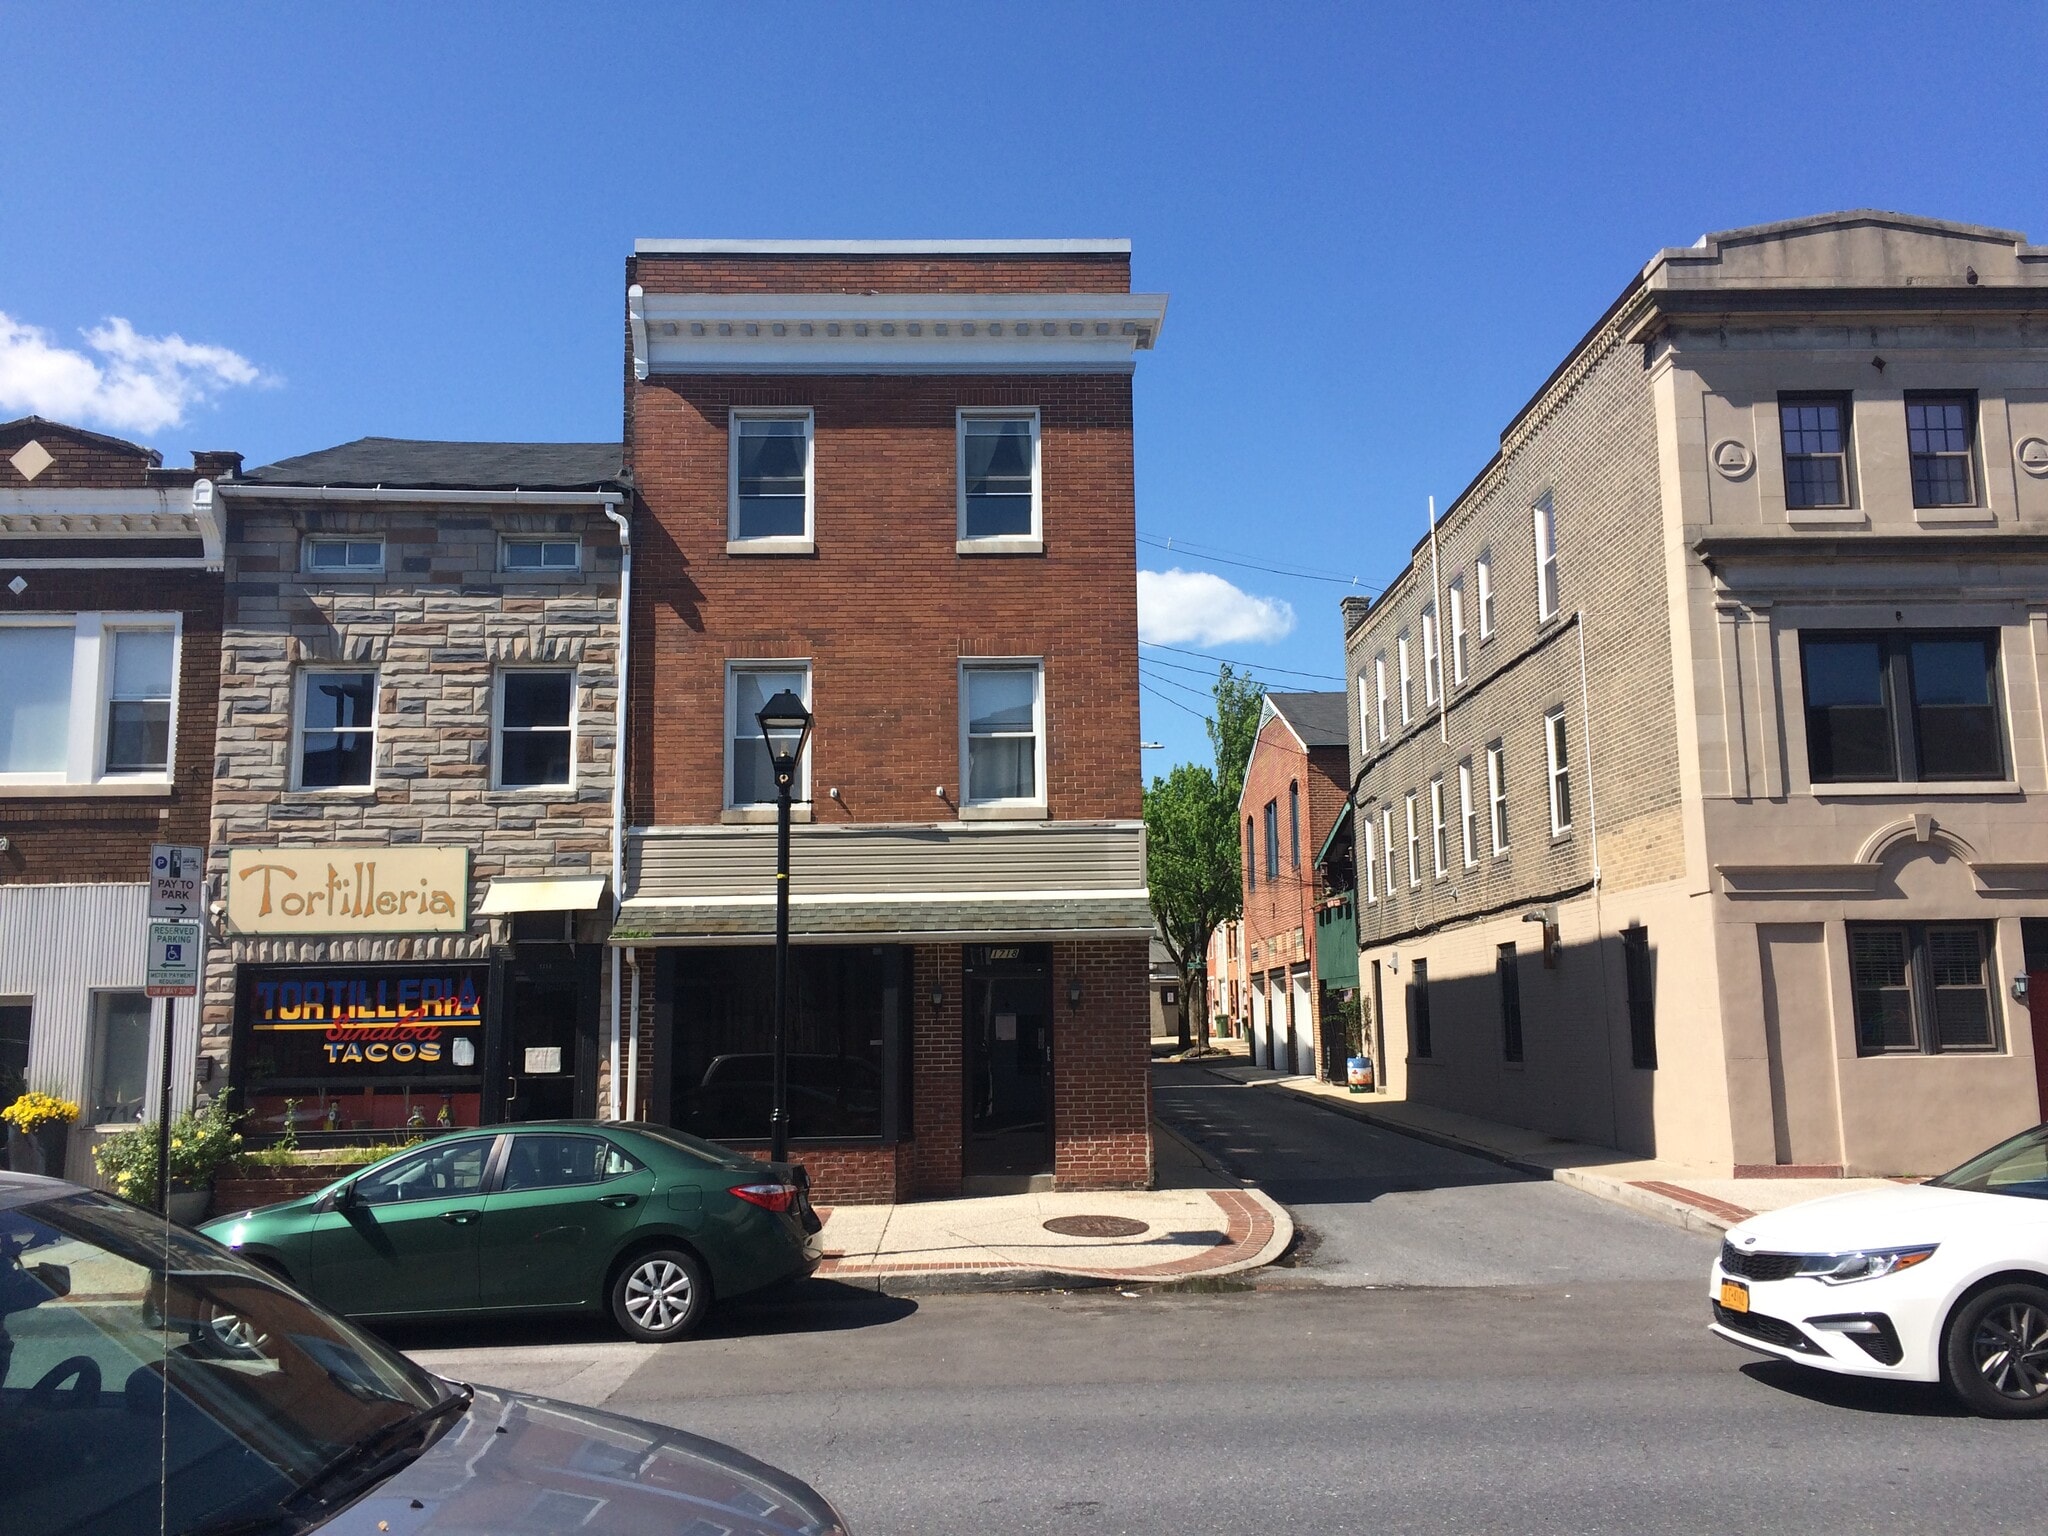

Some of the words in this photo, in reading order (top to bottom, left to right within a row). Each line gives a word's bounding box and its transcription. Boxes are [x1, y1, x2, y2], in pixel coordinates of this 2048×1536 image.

[157, 879, 177, 889] PAY
[180, 880, 194, 890] TO
[239, 861, 456, 918] Tortilleria
[161, 890, 190, 900] PARK
[154, 926, 195, 935] RESERVED
[156, 935, 192, 944] PARKING
[992, 949, 1019, 958] 1718
[161, 987, 177, 995] AWAY
[256, 976, 480, 1020] TORTILLERIA
[325, 1008, 442, 1041] Sinaloa
[323, 1042, 441, 1064] TACOS
